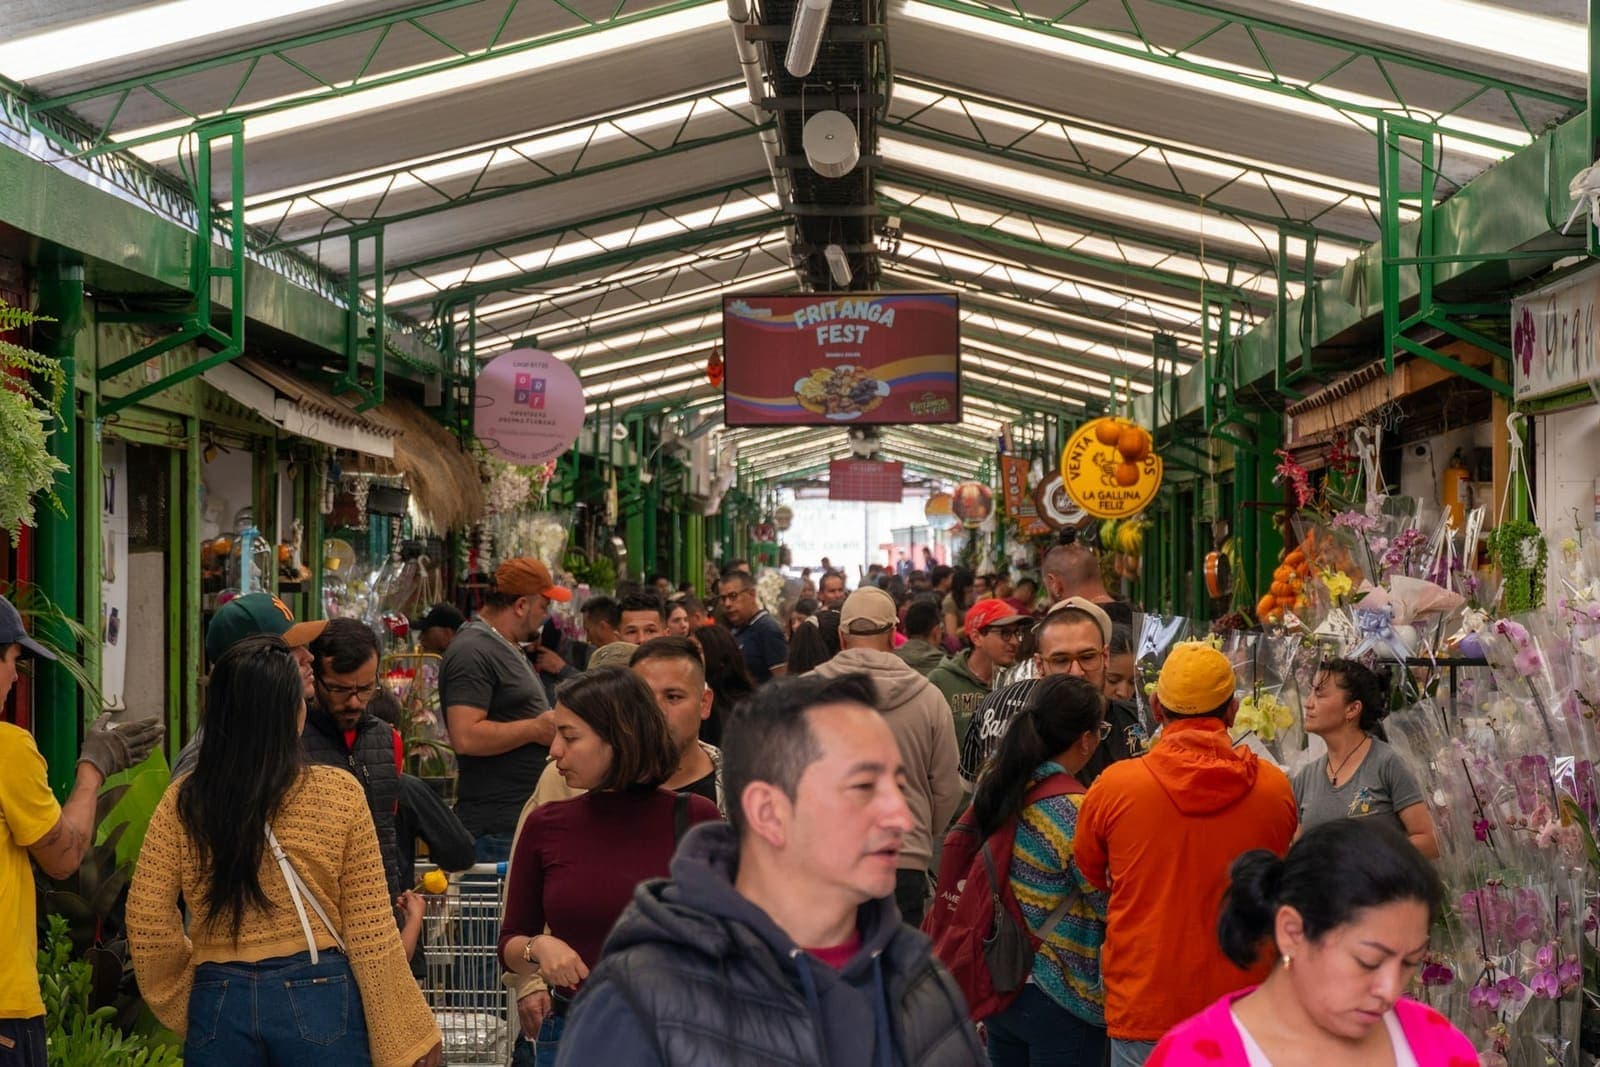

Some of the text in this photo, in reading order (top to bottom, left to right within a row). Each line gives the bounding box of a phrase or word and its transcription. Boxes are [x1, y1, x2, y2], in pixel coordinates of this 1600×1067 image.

[793, 299, 896, 330] FRITANGA
[816, 324, 870, 345] FEST
[1069, 436, 1093, 481] VENTA
[1083, 491, 1141, 500] LA GALLINA
[1099, 501, 1125, 510] FELIZ
[941, 891, 960, 903] AME
